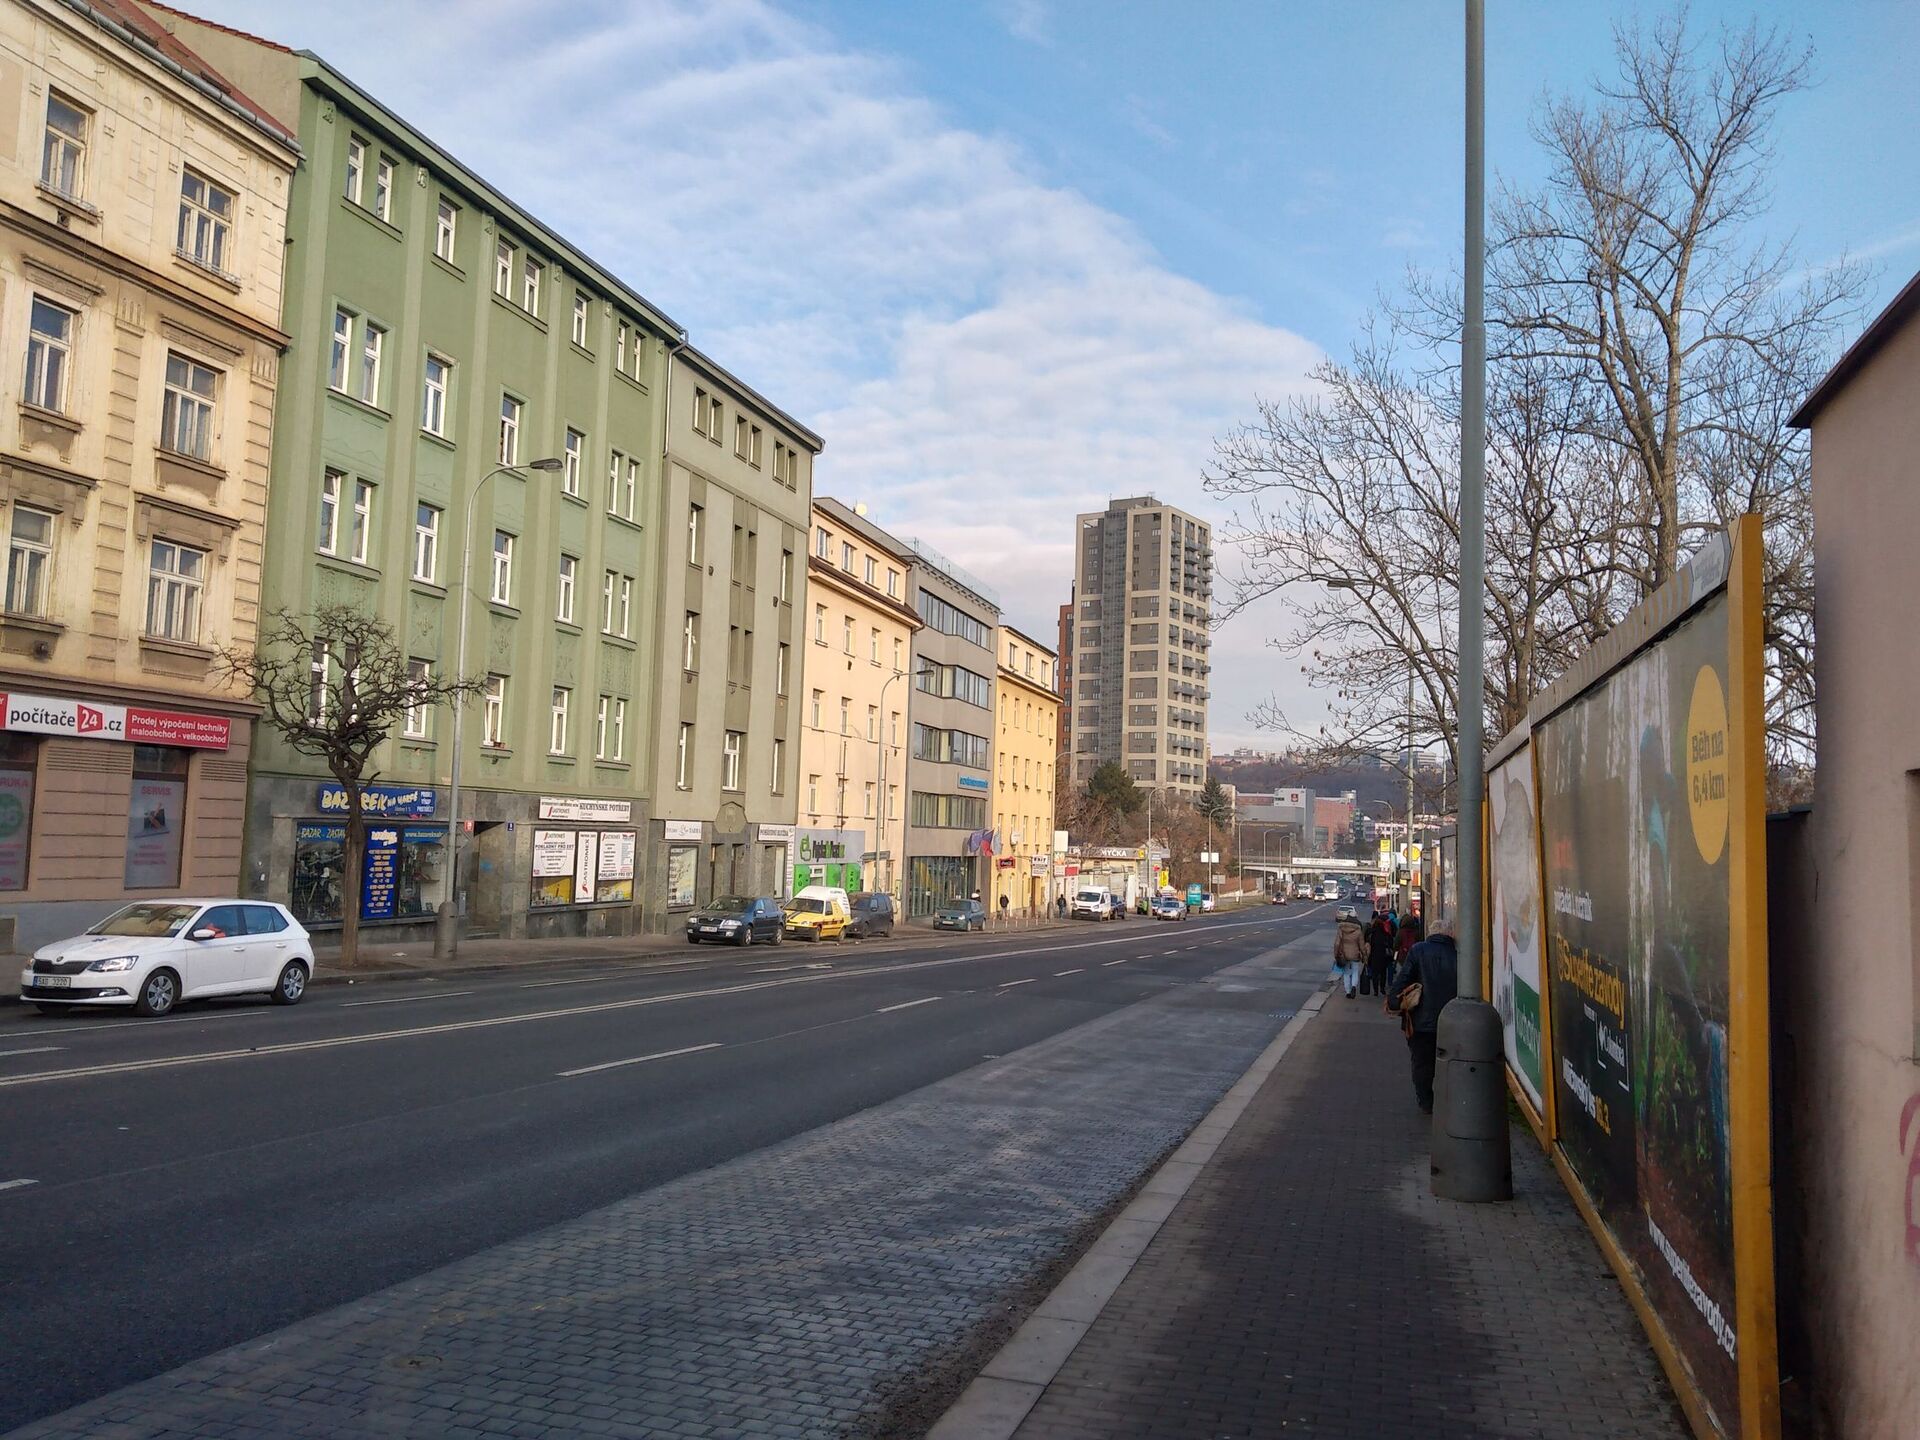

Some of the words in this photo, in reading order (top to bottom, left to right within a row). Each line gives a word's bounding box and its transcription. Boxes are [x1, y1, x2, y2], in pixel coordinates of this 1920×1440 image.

[132, 714, 157, 727] Prodej
[159, 717, 196, 730] výpočetní
[197, 721, 228, 735] techniky
[131, 727, 177, 739] maloobchod
[182, 732, 226, 744] velkoobchod
[1691, 729, 1711, 763] Běh
[1711, 729, 1724, 758] na
[142, 785, 172, 796] SERVIS
[321, 789, 388, 811] BAZREK
